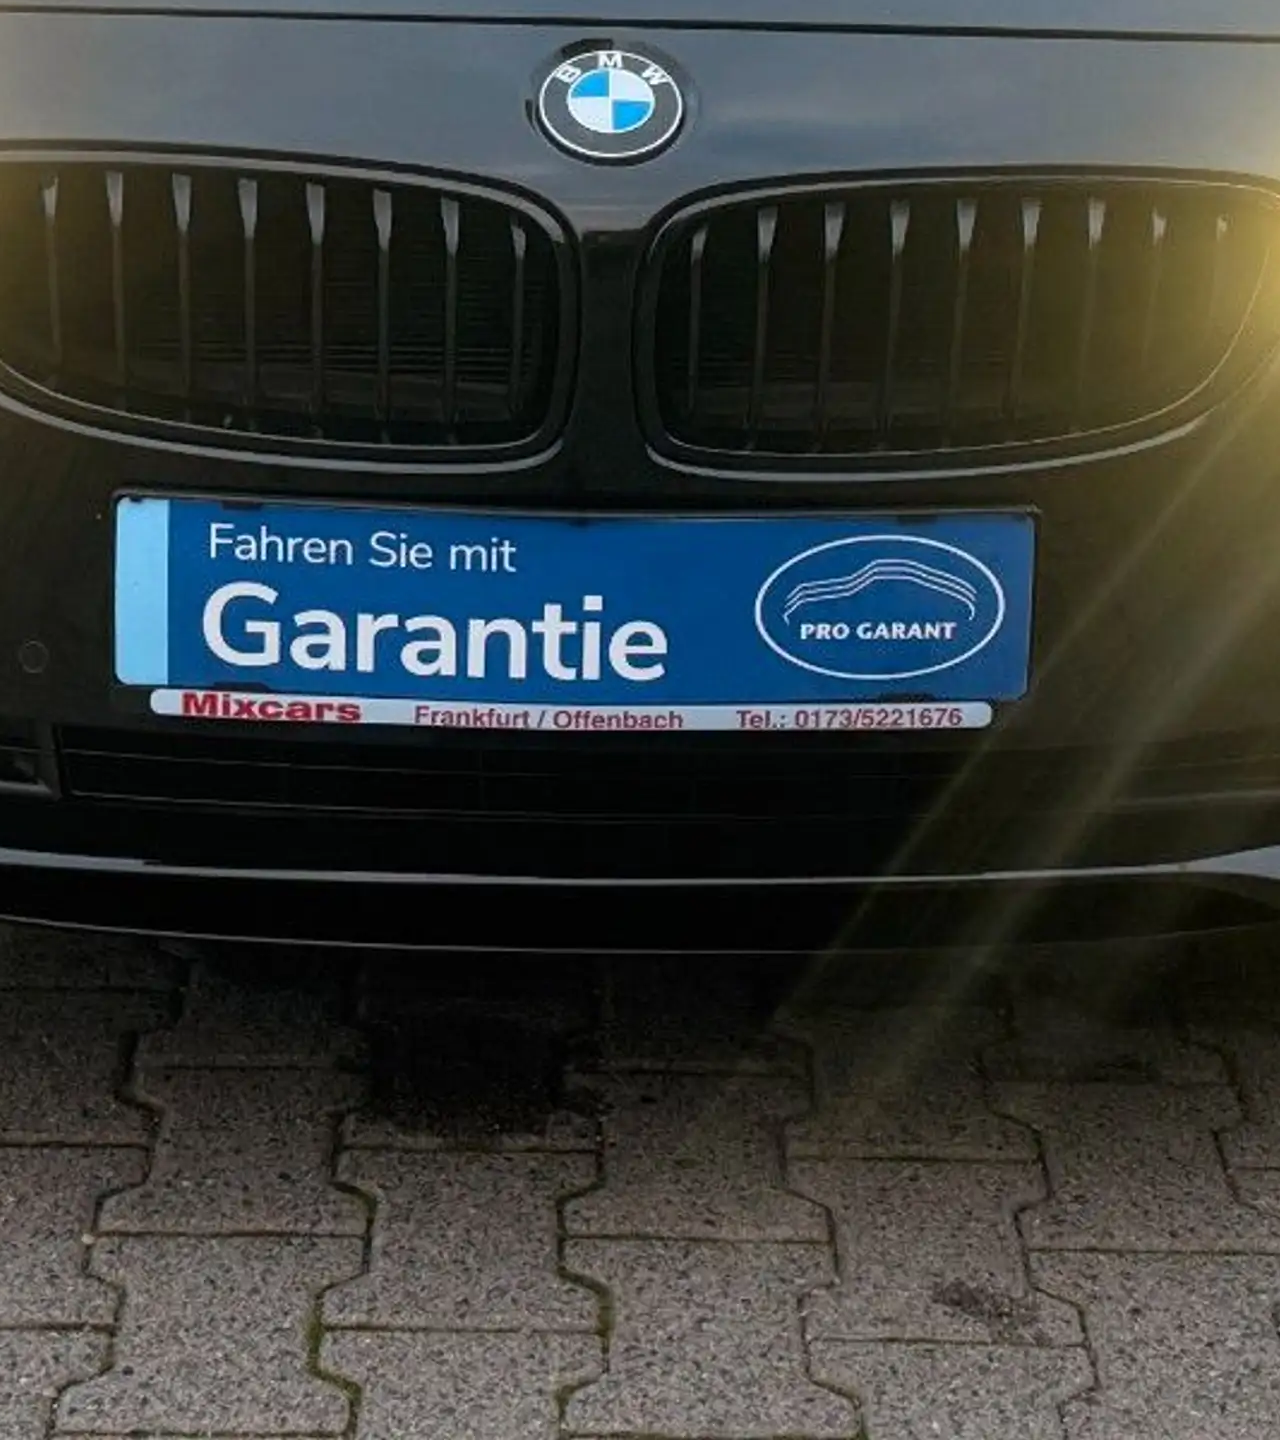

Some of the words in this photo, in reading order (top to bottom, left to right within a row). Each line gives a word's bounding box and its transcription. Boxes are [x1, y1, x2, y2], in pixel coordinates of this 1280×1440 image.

[554, 50, 672, 86] BMW
[208, 522, 354, 566] Fahren
[368, 530, 434, 570] Sie
[448, 536, 518, 573] mit
[202, 580, 669, 682] Garantie
[799, 622, 851, 641] PRO
[856, 621, 958, 641] GARANT
[181, 691, 363, 723] Mixcars
[414, 704, 531, 729] Frankfurt
[552, 709, 685, 730] Offenbach
[736, 710, 787, 729] Tel.:
[794, 708, 964, 729] 0173/5221676
